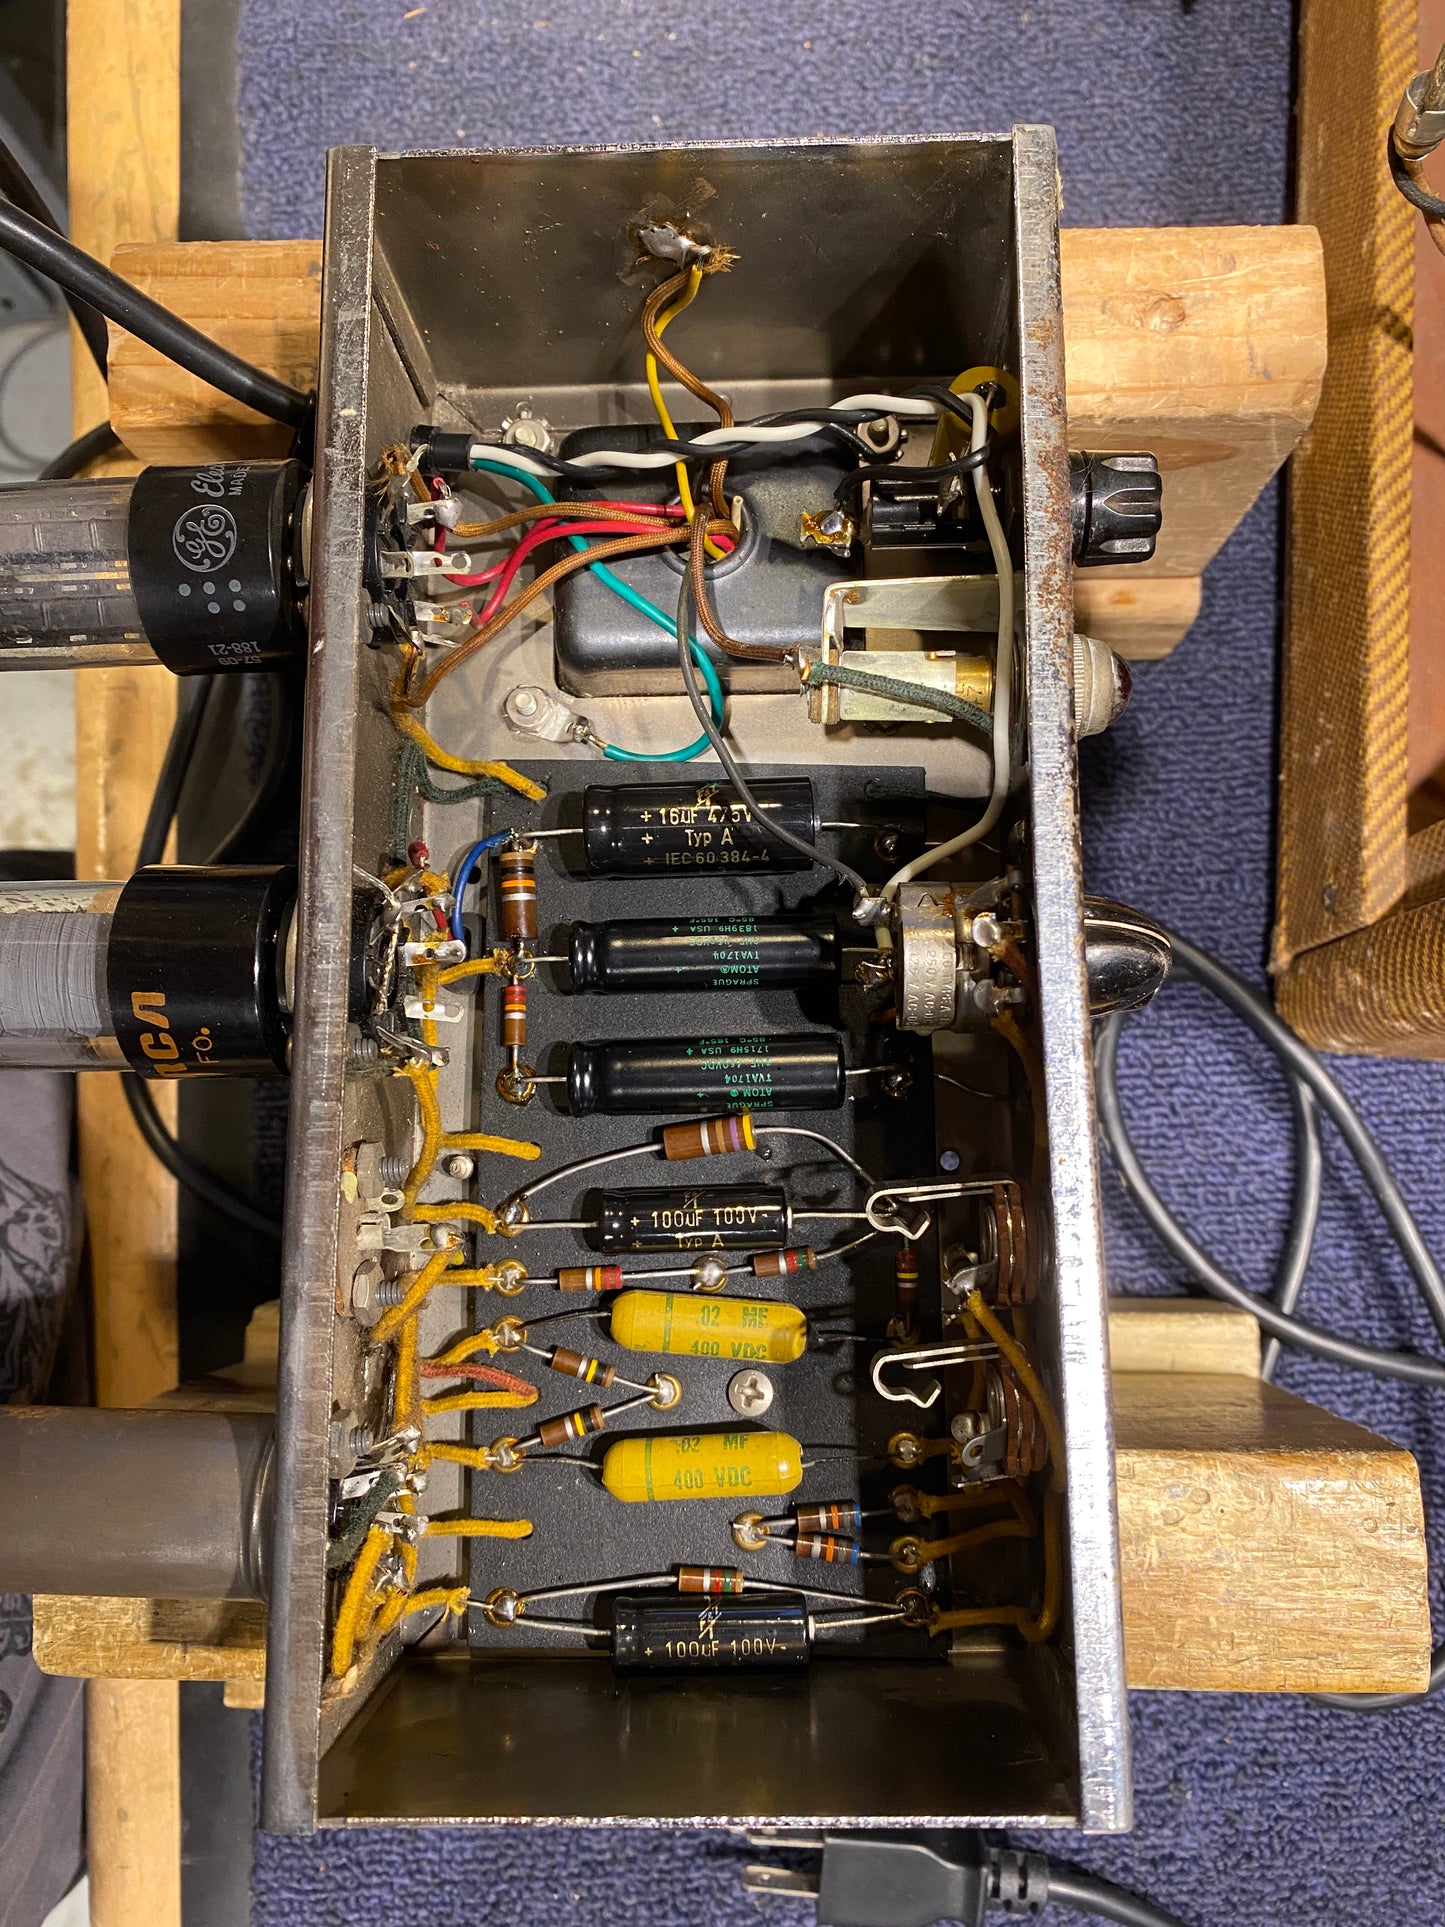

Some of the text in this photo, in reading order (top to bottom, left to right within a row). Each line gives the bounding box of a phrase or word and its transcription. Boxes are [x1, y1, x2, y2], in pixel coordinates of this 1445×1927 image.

[228, 466, 250, 496] MADE
[208, 641, 262, 656] 188-21
[684, 828, 712, 847] Typ
[720, 827, 734, 845] A
[665, 852, 692, 866] IEC
[689, 925, 711, 933] USA
[718, 924, 758, 932] 1839H9
[712, 950, 760, 960] TVA1704
[925, 950, 936, 976] 250
[712, 978, 760, 986] SPRAGUE
[131, 991, 188, 1078] RCA
[700, 1047, 722, 1055] USA
[729, 1045, 769, 1053] 1715H9
[724, 1073, 773, 1084] TVA1704
[674, 1235, 703, 1249] Typ
[712, 1233, 725, 1247] A
[691, 1339, 768, 1360] 400 VDC
[723, 1433, 749, 1450] MF
[673, 1465, 753, 1489] 400 VDC
